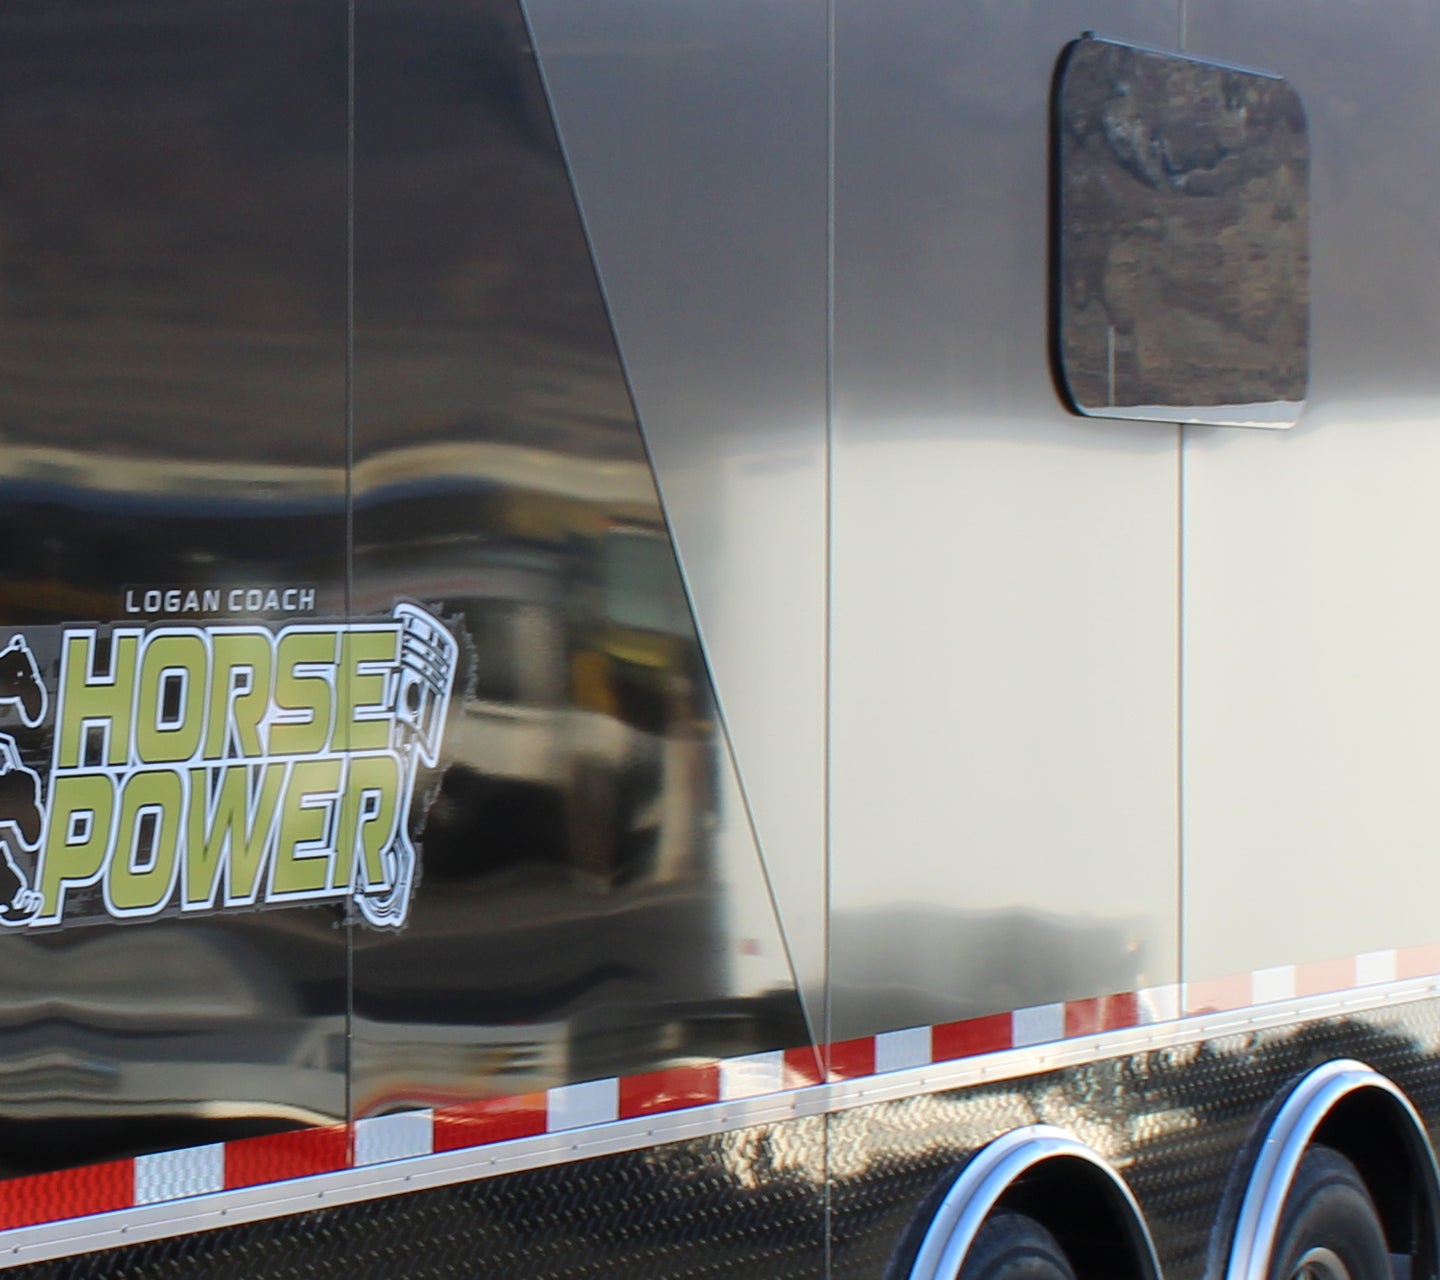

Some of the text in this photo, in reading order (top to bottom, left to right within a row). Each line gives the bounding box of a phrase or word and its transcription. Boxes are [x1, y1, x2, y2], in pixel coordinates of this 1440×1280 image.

[124, 587, 317, 614] LOGAN COACH
[50, 622, 404, 772] HORSE
[28, 750, 404, 928] POWER
